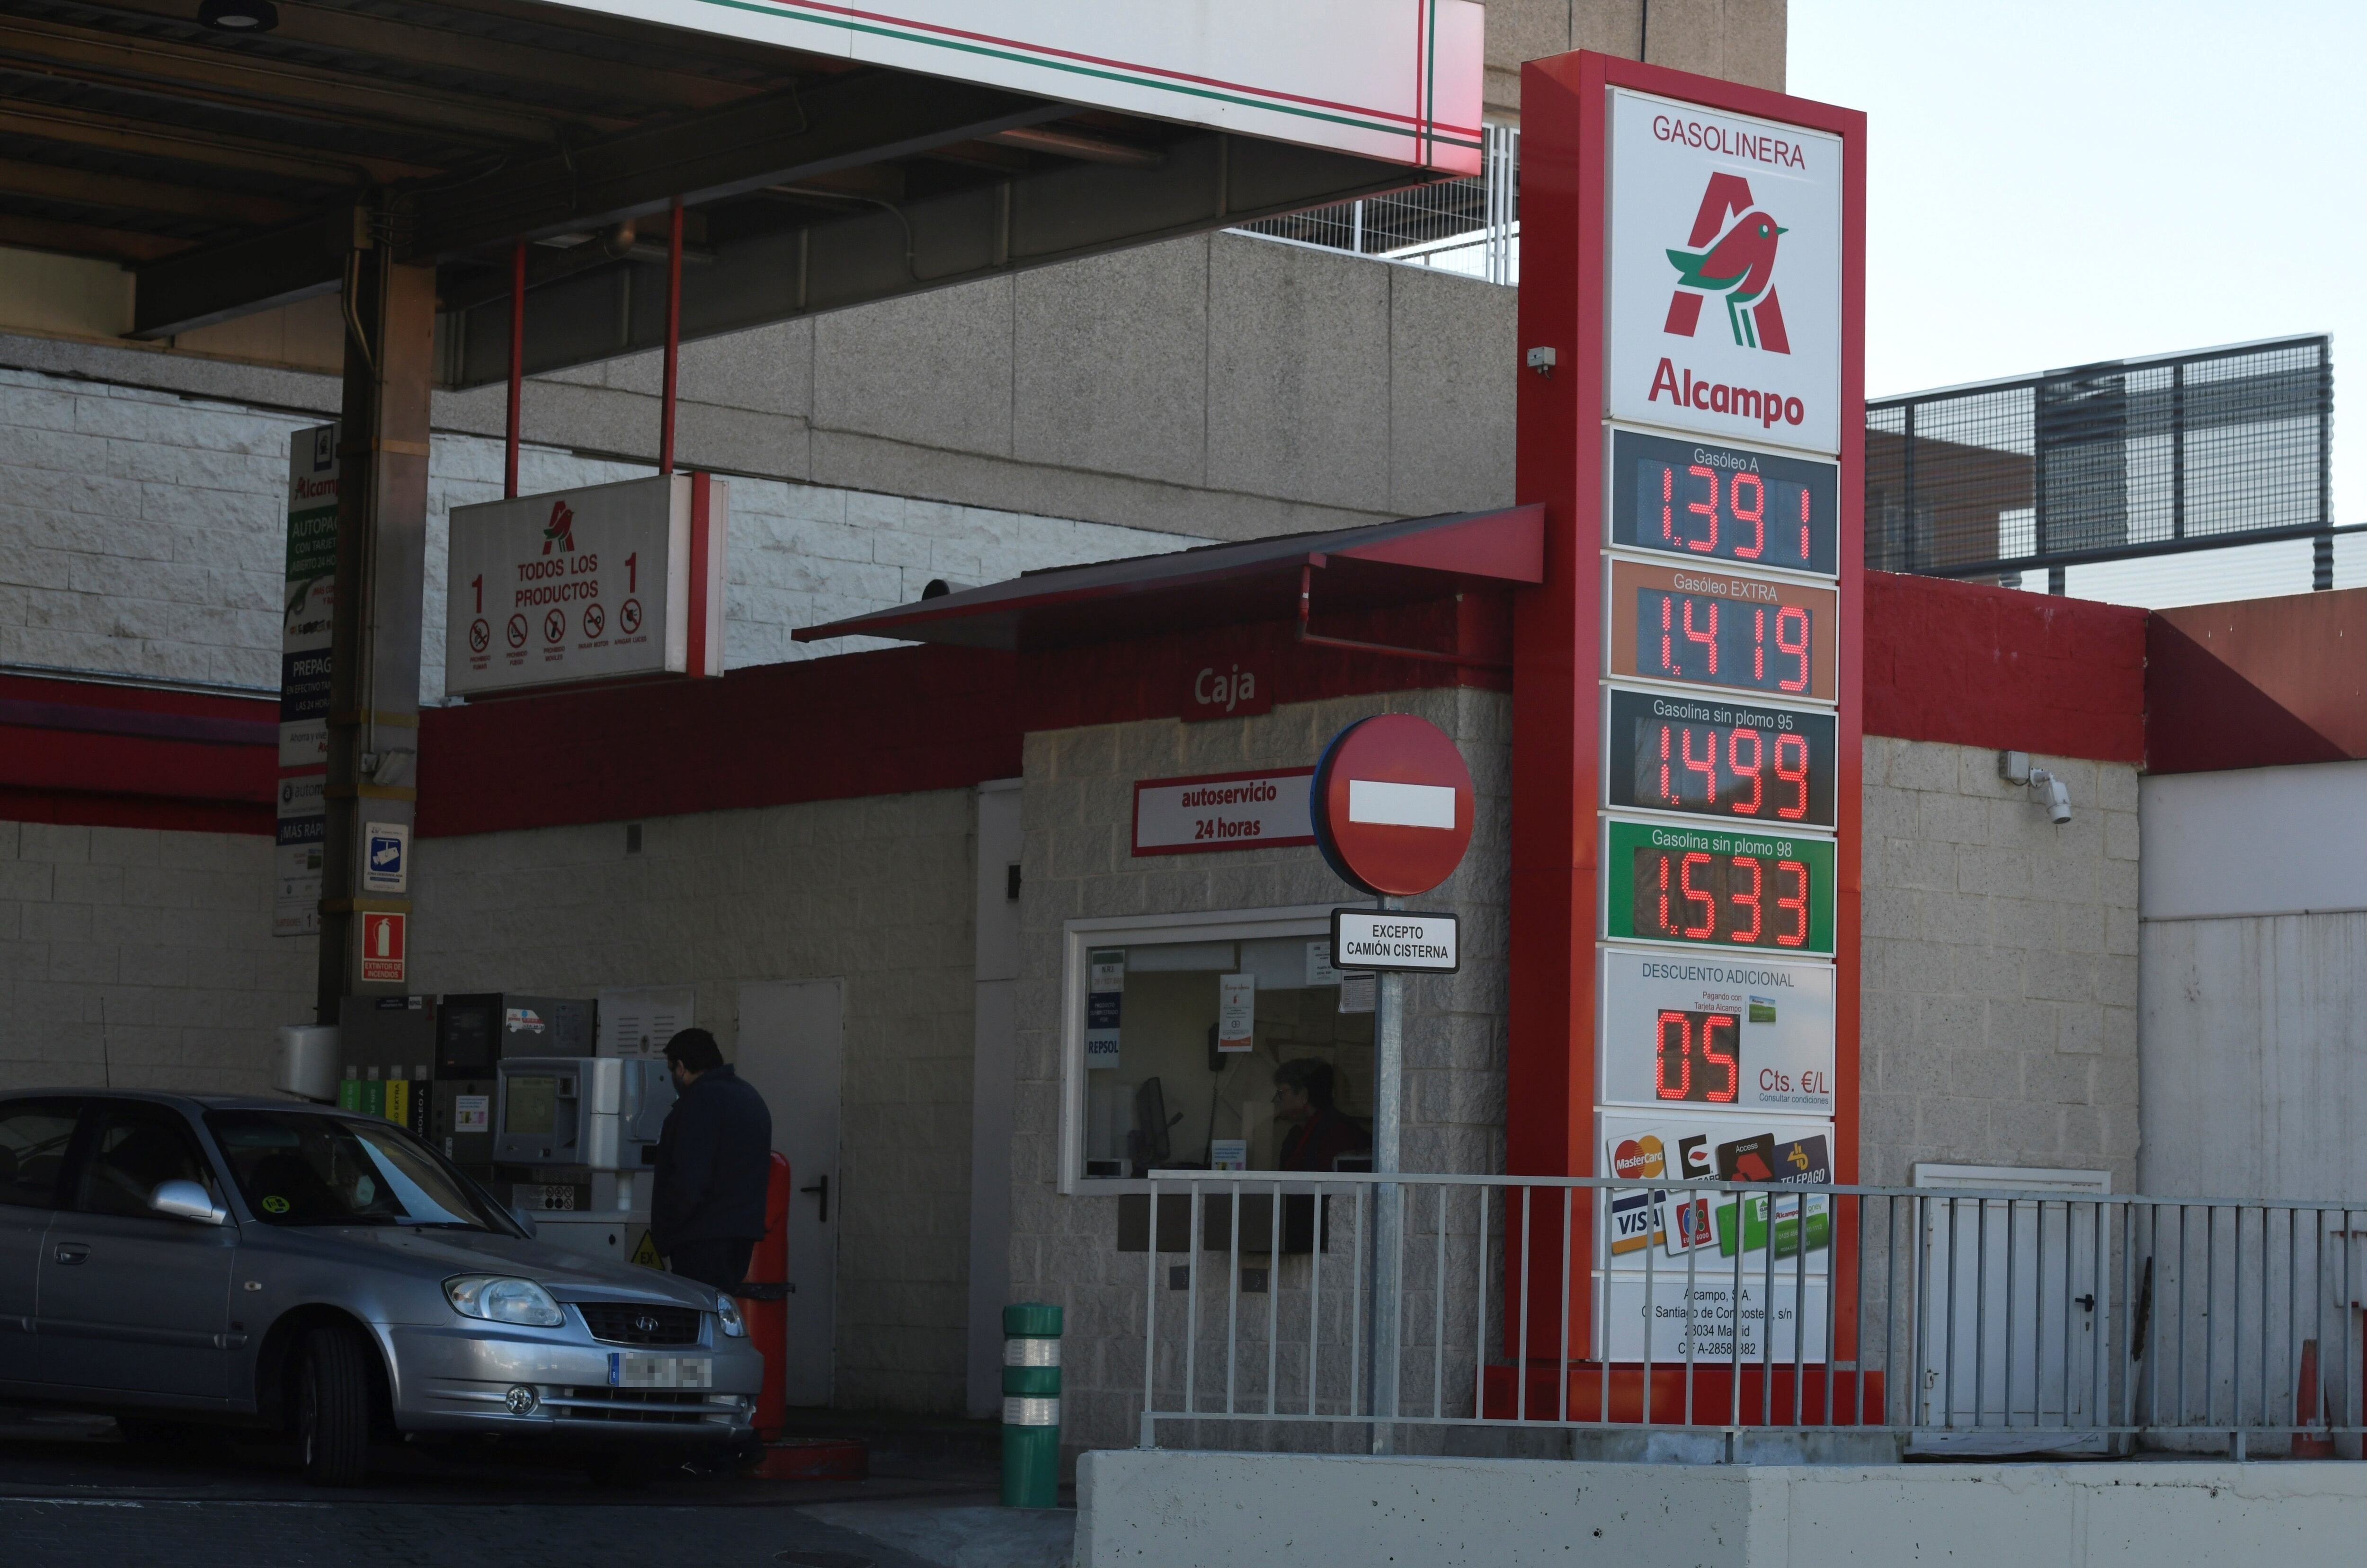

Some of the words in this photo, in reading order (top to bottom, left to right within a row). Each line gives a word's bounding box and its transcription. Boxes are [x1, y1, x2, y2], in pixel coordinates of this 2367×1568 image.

[1653, 115, 1806, 170] GASOLINERA
[1648, 357, 1805, 429] Alcampo
[1694, 448, 1747, 470] Gasóleo
[1749, 457, 1759, 472] A
[294, 476, 340, 501] Alcamp
[1663, 465, 1809, 559] 1.391
[295, 541, 311, 554] CON
[312, 537, 337, 551] TARJET
[518, 558, 564, 582] TODOS
[571, 554, 598, 575] LOS
[624, 552, 637, 593] 1
[471, 574, 483, 613] 1
[515, 580, 598, 608] PRODUCTOS
[1674, 574, 1727, 595] Gasóleo
[1731, 581, 1778, 601] EXTRA
[1662, 597, 1808, 691] 1.419
[293, 656, 331, 678] PREPAG
[1195, 664, 1255, 712] Caja
[1654, 700, 1709, 721] Gasolina
[1713, 707, 1731, 723] sin
[1735, 710, 1774, 728] plomo
[1777, 715, 1793, 730] 95
[1661, 726, 1807, 818] 1.499
[294, 784, 324, 798] autom
[1182, 781, 1277, 807] autoservicio
[304, 819, 326, 837] RÁPI
[1195, 820, 1214, 840] 24
[1217, 817, 1260, 838] horas
[1652, 829, 1709, 850] Gasolina
[1712, 836, 1731, 851] sin
[1734, 839, 1772, 856] plomo
[1777, 842, 1792, 857] 98
[1659, 852, 1806, 946] 1.533
[1372, 924, 1424, 940] EXCEPTO
[1347, 940, 1391, 957] CAMIÓN
[1394, 943, 1449, 959] CISTERNA
[365, 962, 392, 970] EXTINTOR
[1642, 963, 1724, 983] DESCUENTO
[1726, 969, 1795, 987] ADICIONAL
[1694, 1002, 1714, 1012] Tarjeta
[1716, 1003, 1742, 1013] Alcampo
[1702, 991, 1729, 1002] Pagando
[1088, 1040, 1119, 1054] REPSOL
[1656, 1012, 1736, 1102] 05
[1759, 1068, 1795, 1092] Cts.
[1801, 1071, 1829, 1094] €/L
[419, 1089, 424, 1097] A
[1759, 1093, 1790, 1103] Consultar
[1792, 1095, 1829, 1105] condiciones
[1735, 1143, 1758, 1153] Access
[1616, 1152, 1663, 1170] MasterCard
[1780, 1168, 1825, 1184] TELEPAGO
[1617, 1208, 1660, 1235] VISA
[641, 1252, 654, 1264] EX
[1684, 1289, 1728, 1303] Acampo,
[1655, 1306, 1698, 1320] Santiao
[1701, 1307, 1713, 1318] de
[1716, 1307, 1775, 1320] Cooste,
[1778, 1308, 1792, 1320] s/n
[1717, 1325, 1750, 1337] Maid
[1698, 1343, 1756, 1355] A-285882
